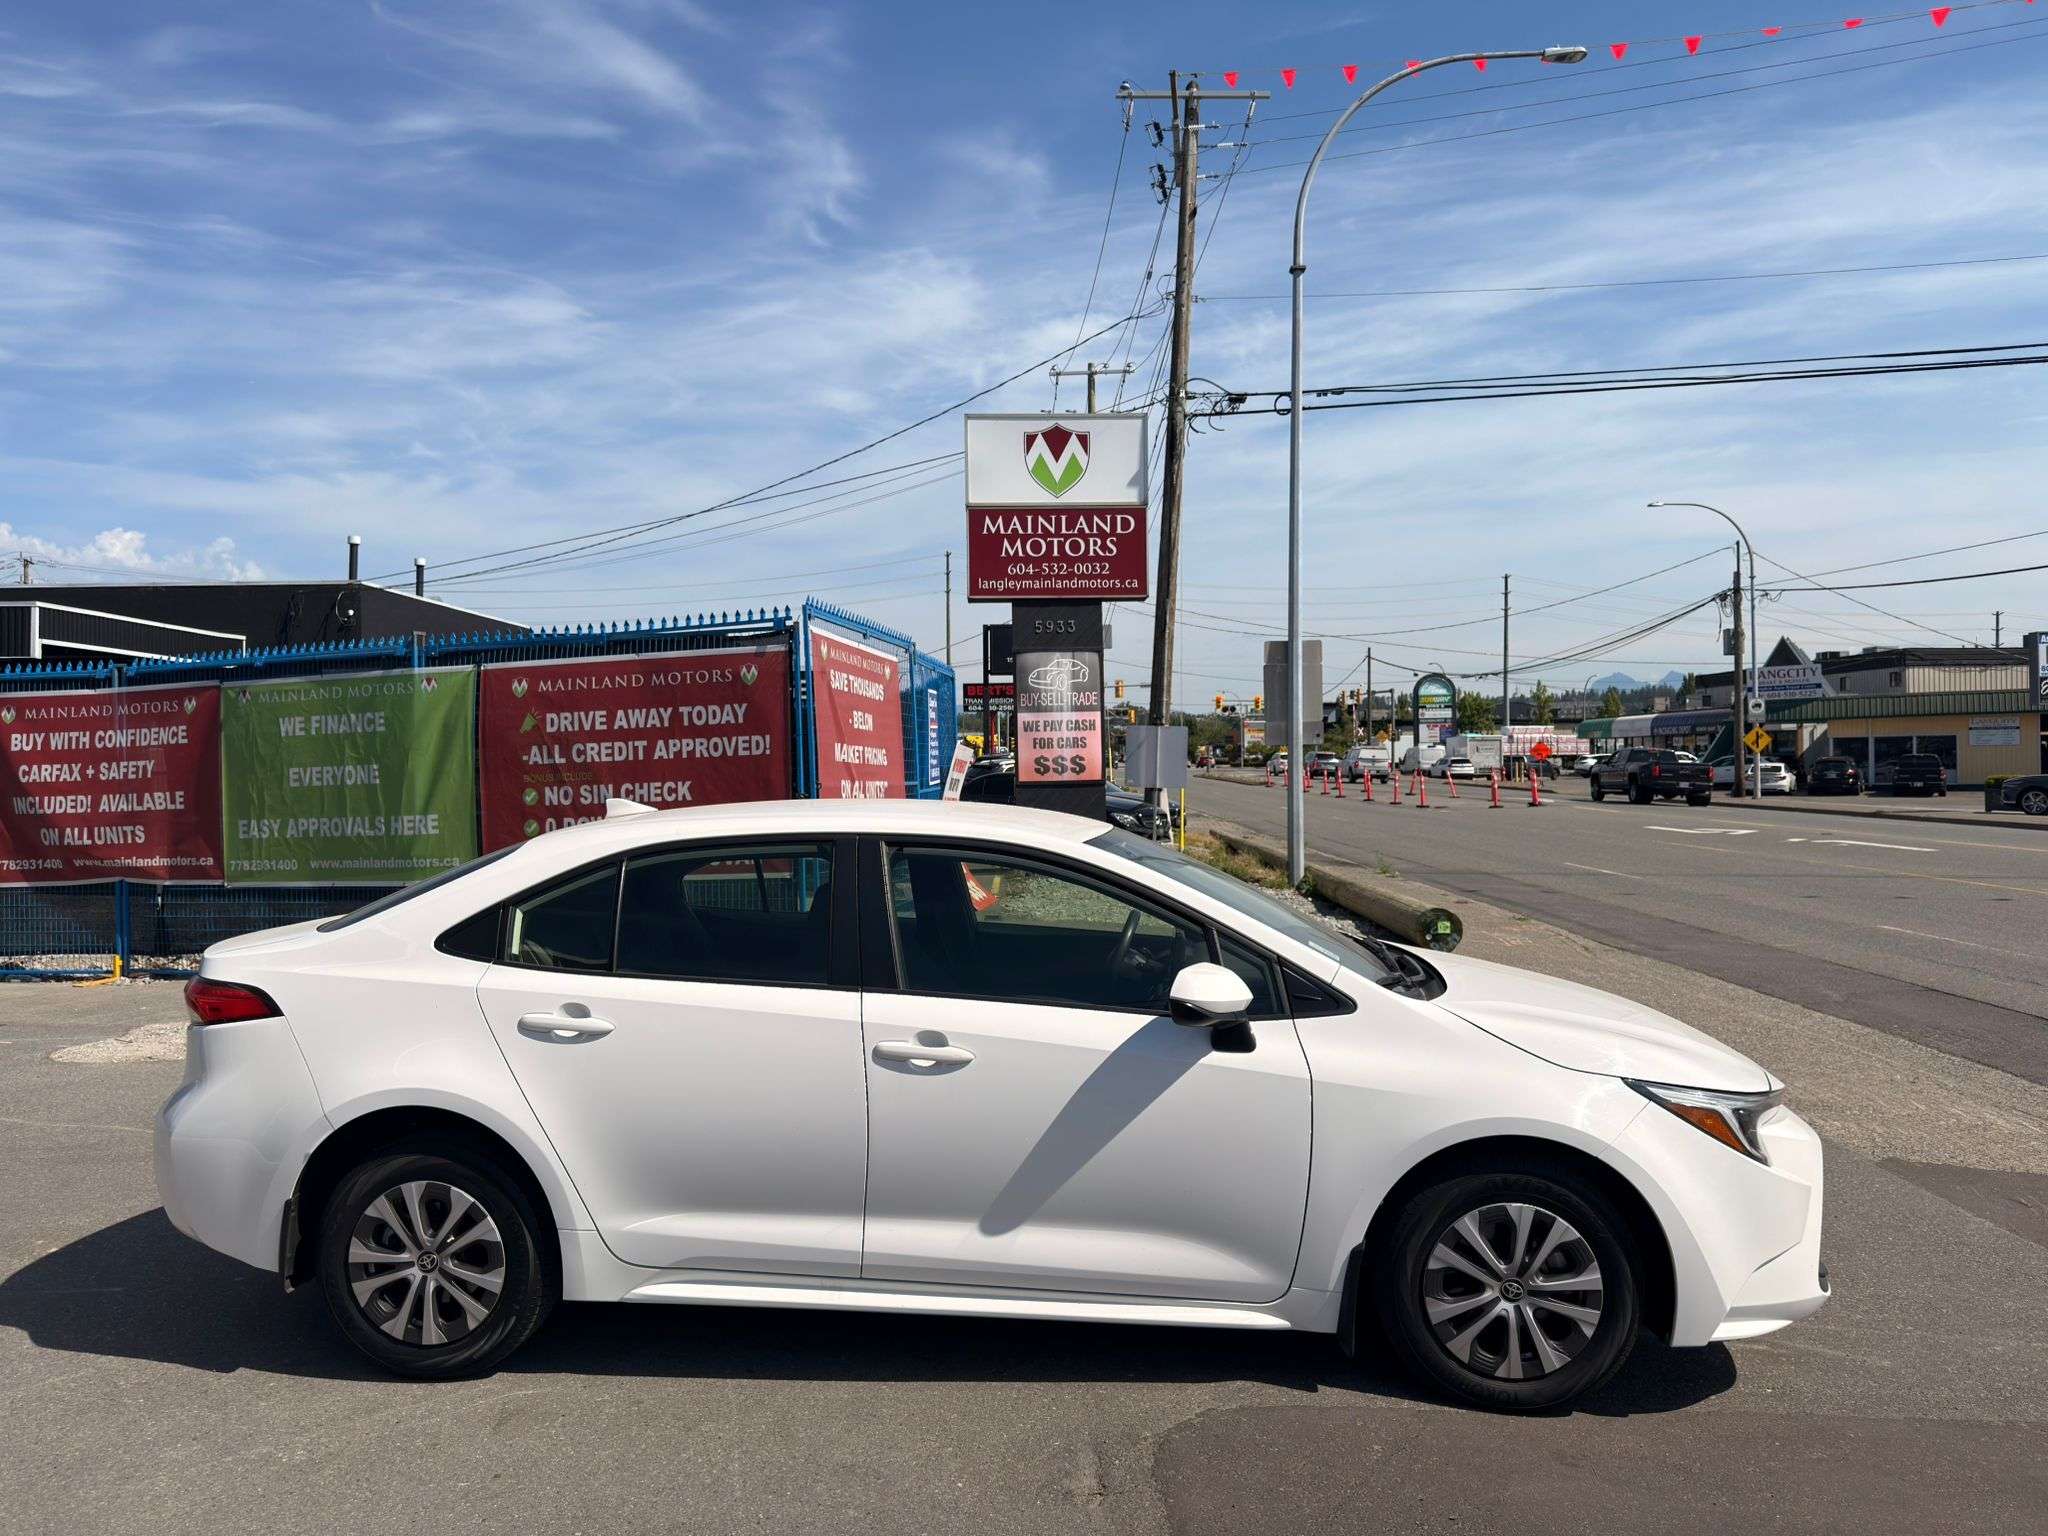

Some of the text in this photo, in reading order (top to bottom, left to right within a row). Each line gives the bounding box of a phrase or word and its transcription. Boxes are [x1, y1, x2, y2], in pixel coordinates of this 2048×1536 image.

[982, 514, 1136, 535] MAINLAND
[1000, 537, 1118, 557] MOTORS
[1008, 562, 1110, 575] 604-532-0032
[978, 577, 1139, 591] langleymainlandmotors.ca
[1034, 619, 1077, 634] 5933
[538, 668, 733, 693] MAINLAND MOTORS
[830, 669, 885, 702] SAVE THOUSANDS
[258, 682, 414, 703] MAINLAND MOTORS
[24, 700, 179, 720] MAINLAND MOTORS
[545, 703, 748, 733] DRIVE AWAY TODAY
[279, 711, 386, 737] WE FINANCE
[1022, 719, 1097, 733] WE PAY CASH
[10, 725, 189, 752] BUY WITH CONFIDENCE
[571, 740, 648, 762] CREDIT
[653, 735, 771, 760] APPROVED!
[1032, 736, 1087, 749] FOR CARS
[18, 763, 82, 783] CARFAX
[99, 760, 156, 780] SAFETY
[288, 764, 381, 787] EVERYONE
[1033, 754, 1087, 776] $$$
[13, 791, 185, 815] INCLUDED! AVAILABLE
[544, 780, 693, 806] NO SIN CHECK
[40, 825, 146, 846] ON ALL UNITS
[238, 814, 440, 839] EASY APPROVALS HERE
[73, 856, 215, 868] www.mainlandmotors.ca
[309, 856, 461, 869] www.mainlandmotors.ca
